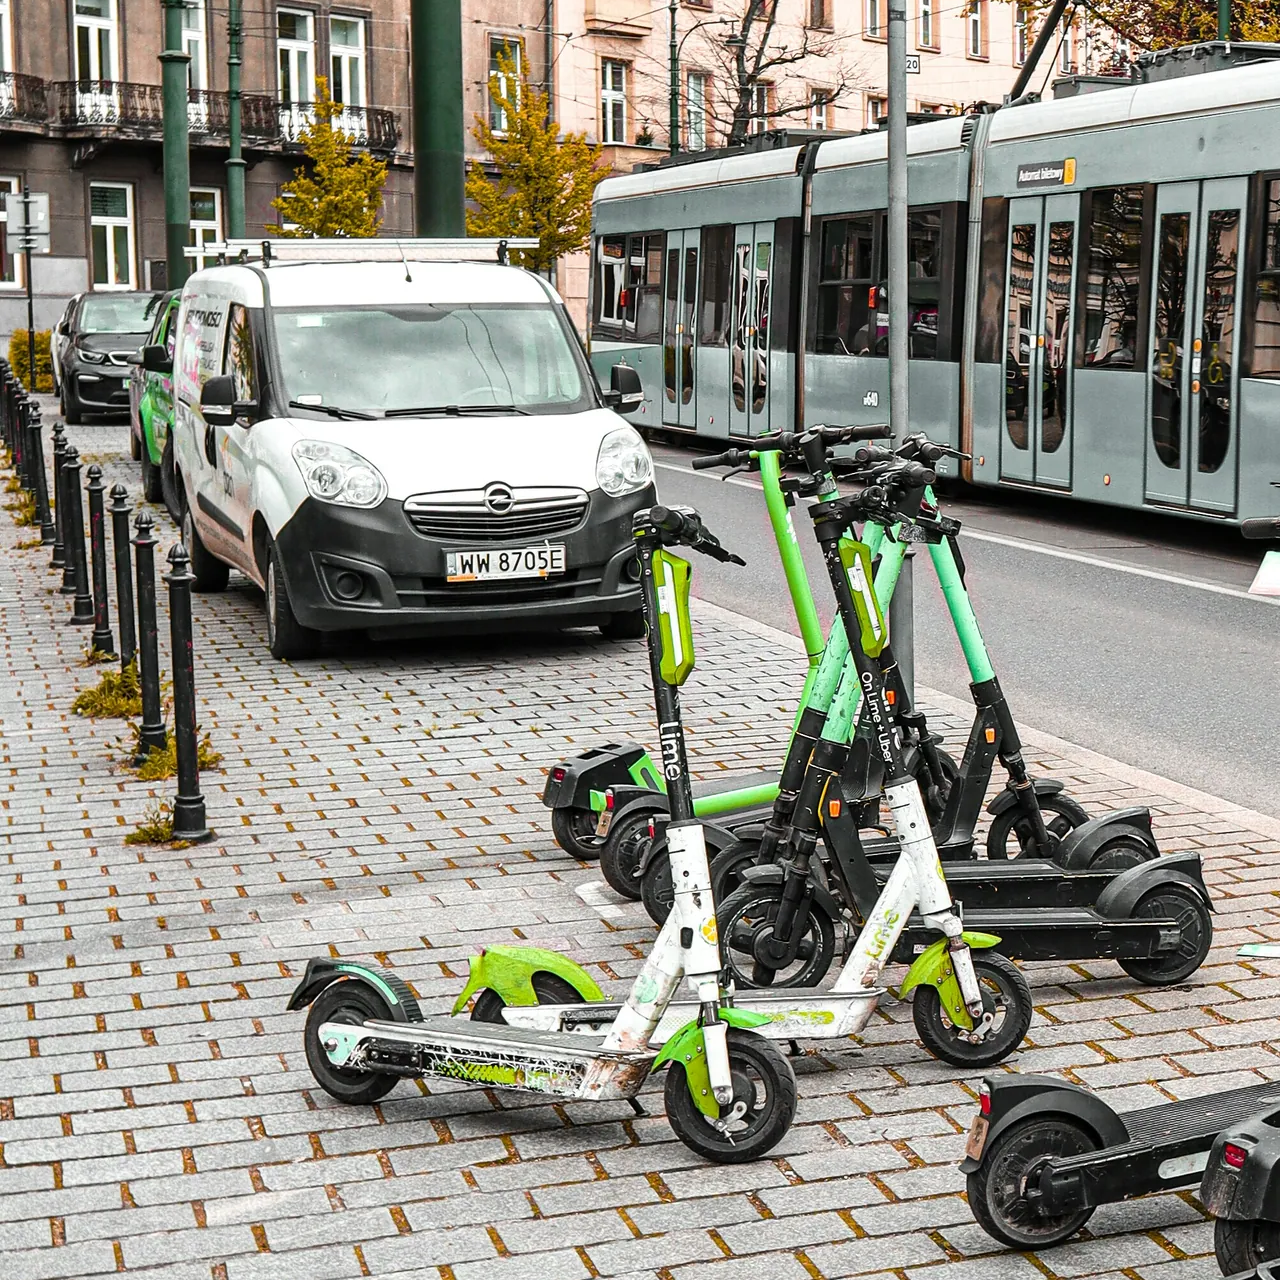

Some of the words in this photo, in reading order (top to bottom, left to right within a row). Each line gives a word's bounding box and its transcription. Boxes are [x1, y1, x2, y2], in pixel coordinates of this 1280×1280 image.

[460, 553, 490, 574] WW
[499, 549, 563, 572] 8705E
[861, 671, 873, 692] On
[867, 691, 882, 723] Lime
[878, 732, 894, 763] Uber
[660, 721, 681, 781] Lime
